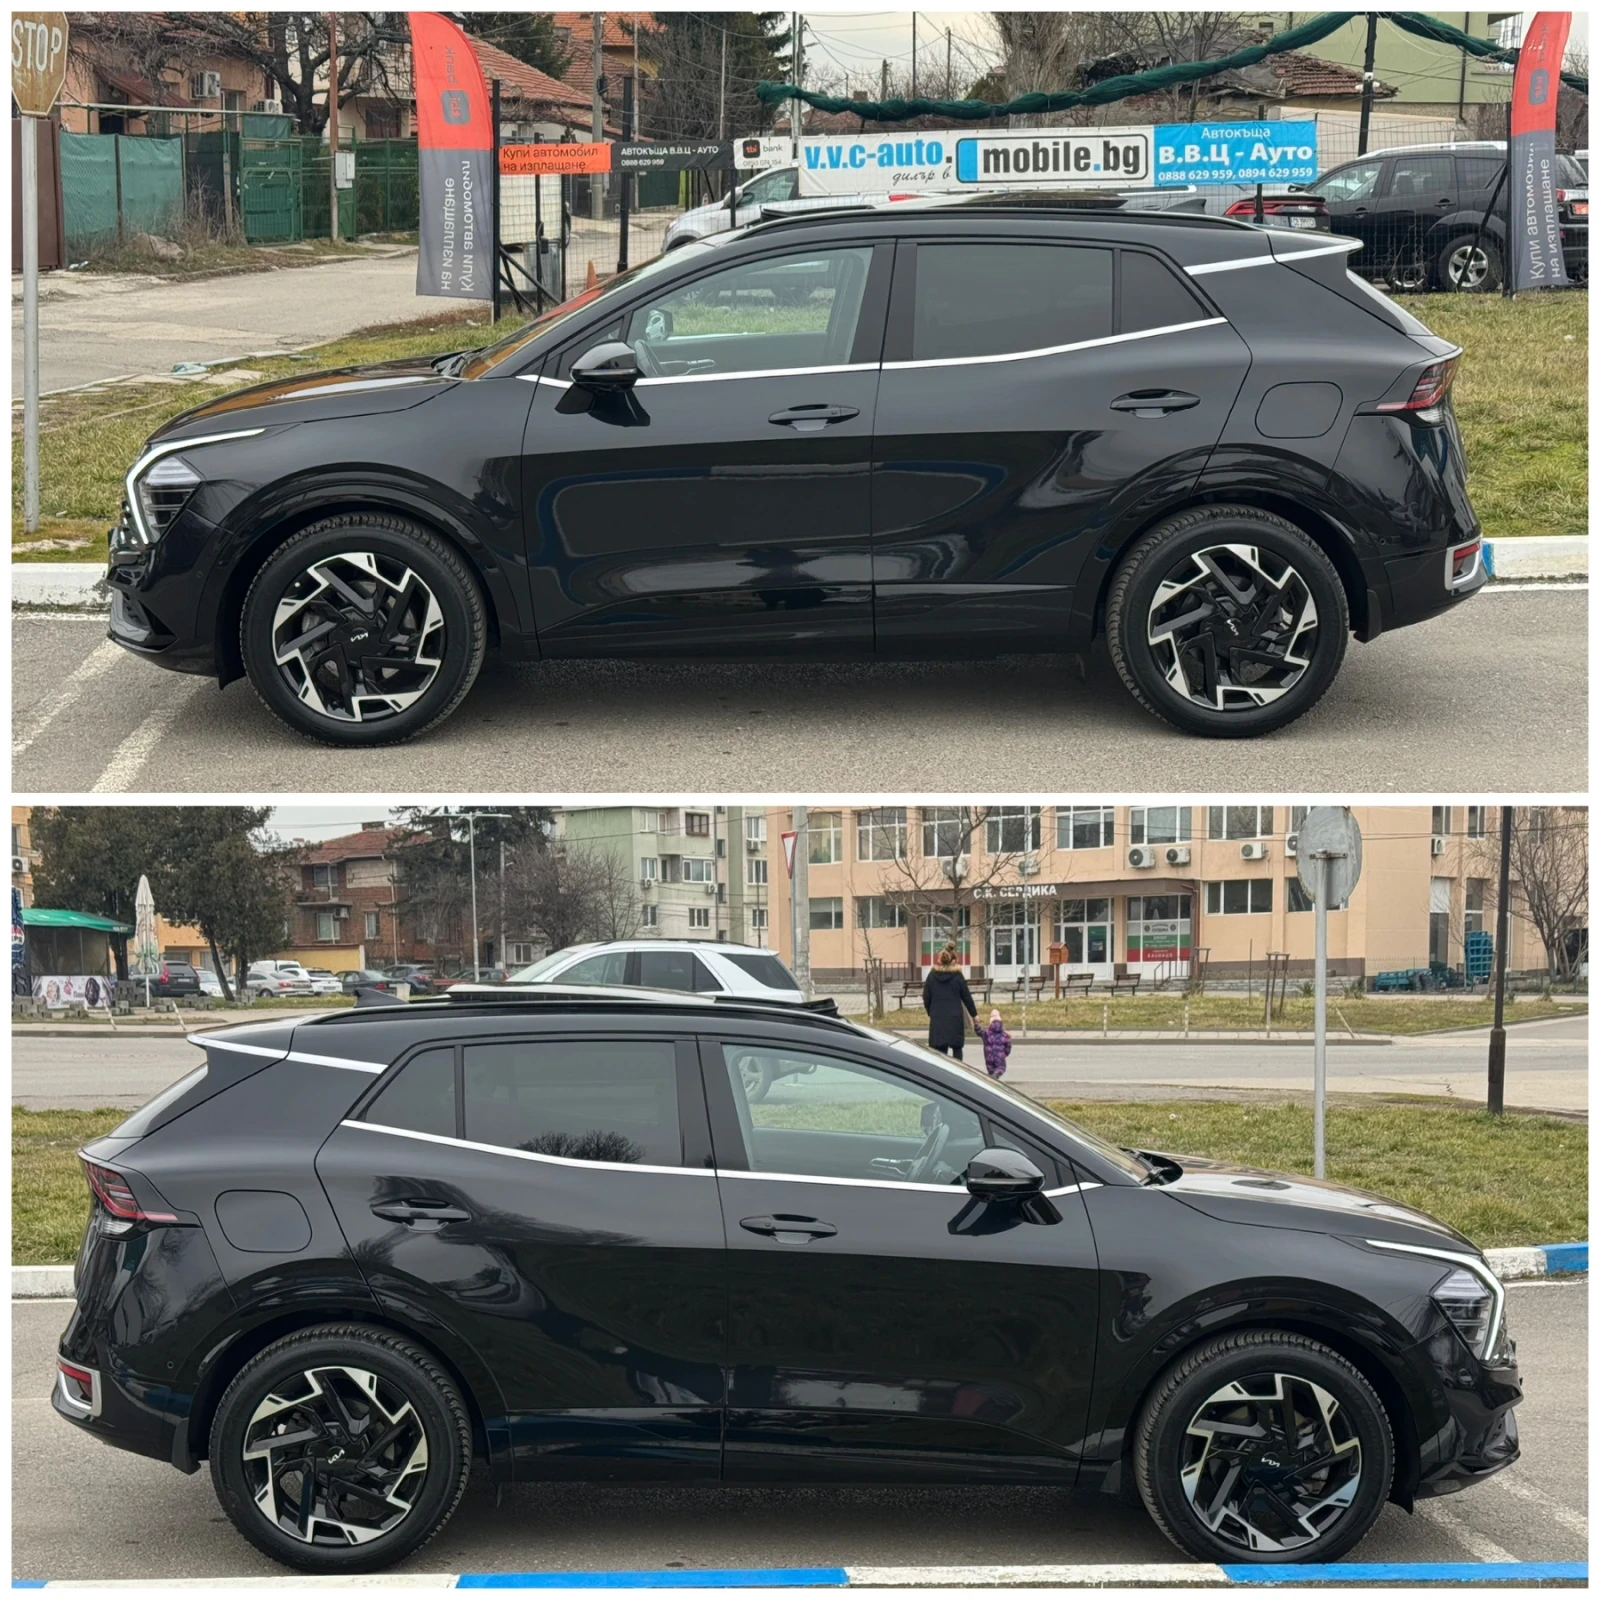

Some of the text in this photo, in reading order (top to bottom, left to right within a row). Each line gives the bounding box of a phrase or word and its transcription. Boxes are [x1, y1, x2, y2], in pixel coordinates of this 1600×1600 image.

[12, 19, 62, 72] STOP
[1201, 127, 1271, 140] Автокъща
[503, 146, 598, 160] Купи автомобил
[621, 146, 668, 156] АВТОКЪЩА
[697, 146, 719, 154] АУТО
[763, 143, 783, 153] bank
[1159, 143, 1230, 166] В.В.Ц
[1250, 142, 1313, 165] Ауто
[983, 140, 1140, 175] mobile.bg
[503, 160, 586, 172] на изплащане
[892, 171, 936, 187] дилър
[1158, 167, 1313, 181] 0888 629 959, 0894 629 959
[1528, 239, 1546, 280] Купи
[1550, 257, 1561, 278] на
[999, 884, 1058, 899] СЕРДИКА
